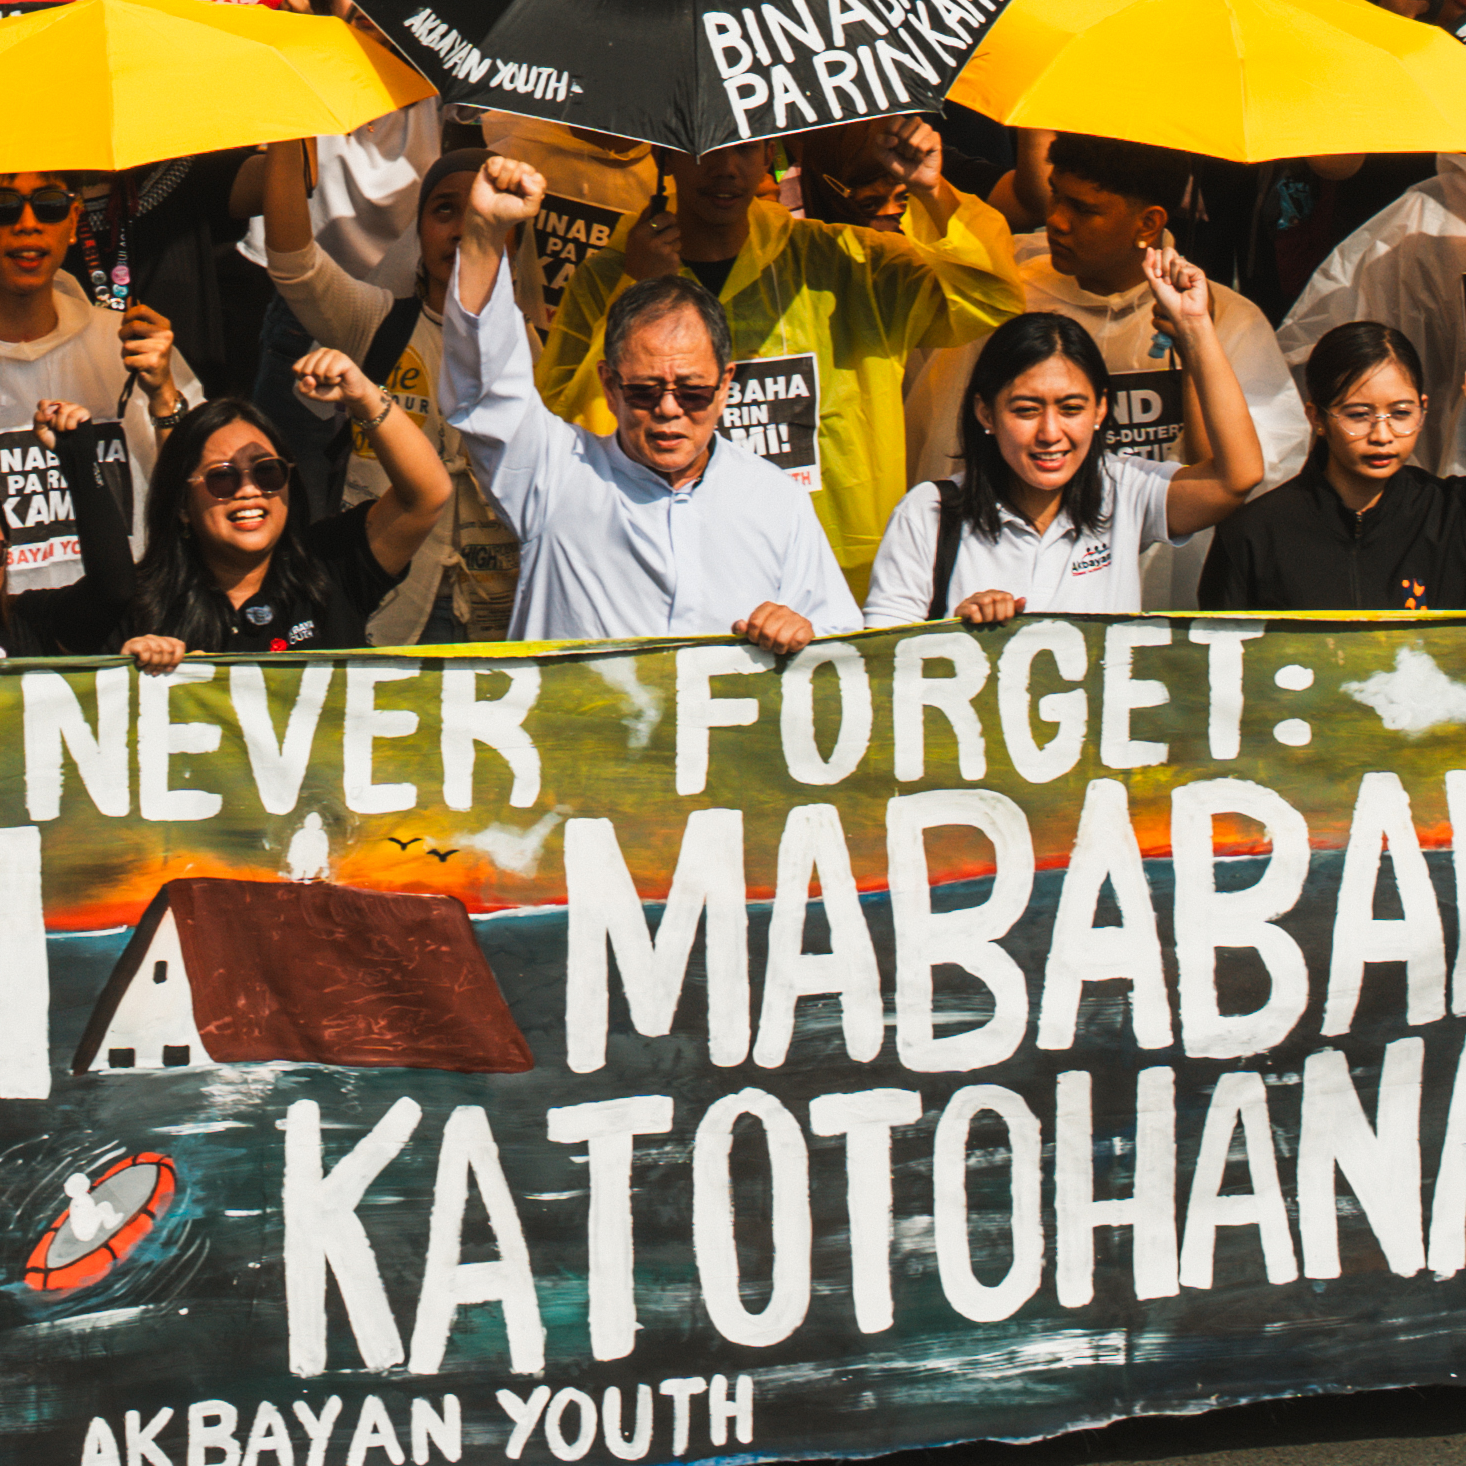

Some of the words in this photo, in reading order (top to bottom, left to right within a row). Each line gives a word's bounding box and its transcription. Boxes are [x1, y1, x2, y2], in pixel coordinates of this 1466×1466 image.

[402, 5, 493, 86] AKBAYAN
[488, 57, 571, 103] YOUTH
[722, 64, 818, 141] PA
[545, 236, 579, 263] PA
[722, 403, 769, 428] RIN
[7, 474, 44, 496] PA
[22, 662, 542, 823] NEVER
[673, 617, 1315, 798] FORGET:
[81, 1391, 465, 1466] AKBAYAN
[496, 1372, 754, 1464] YOUTH
